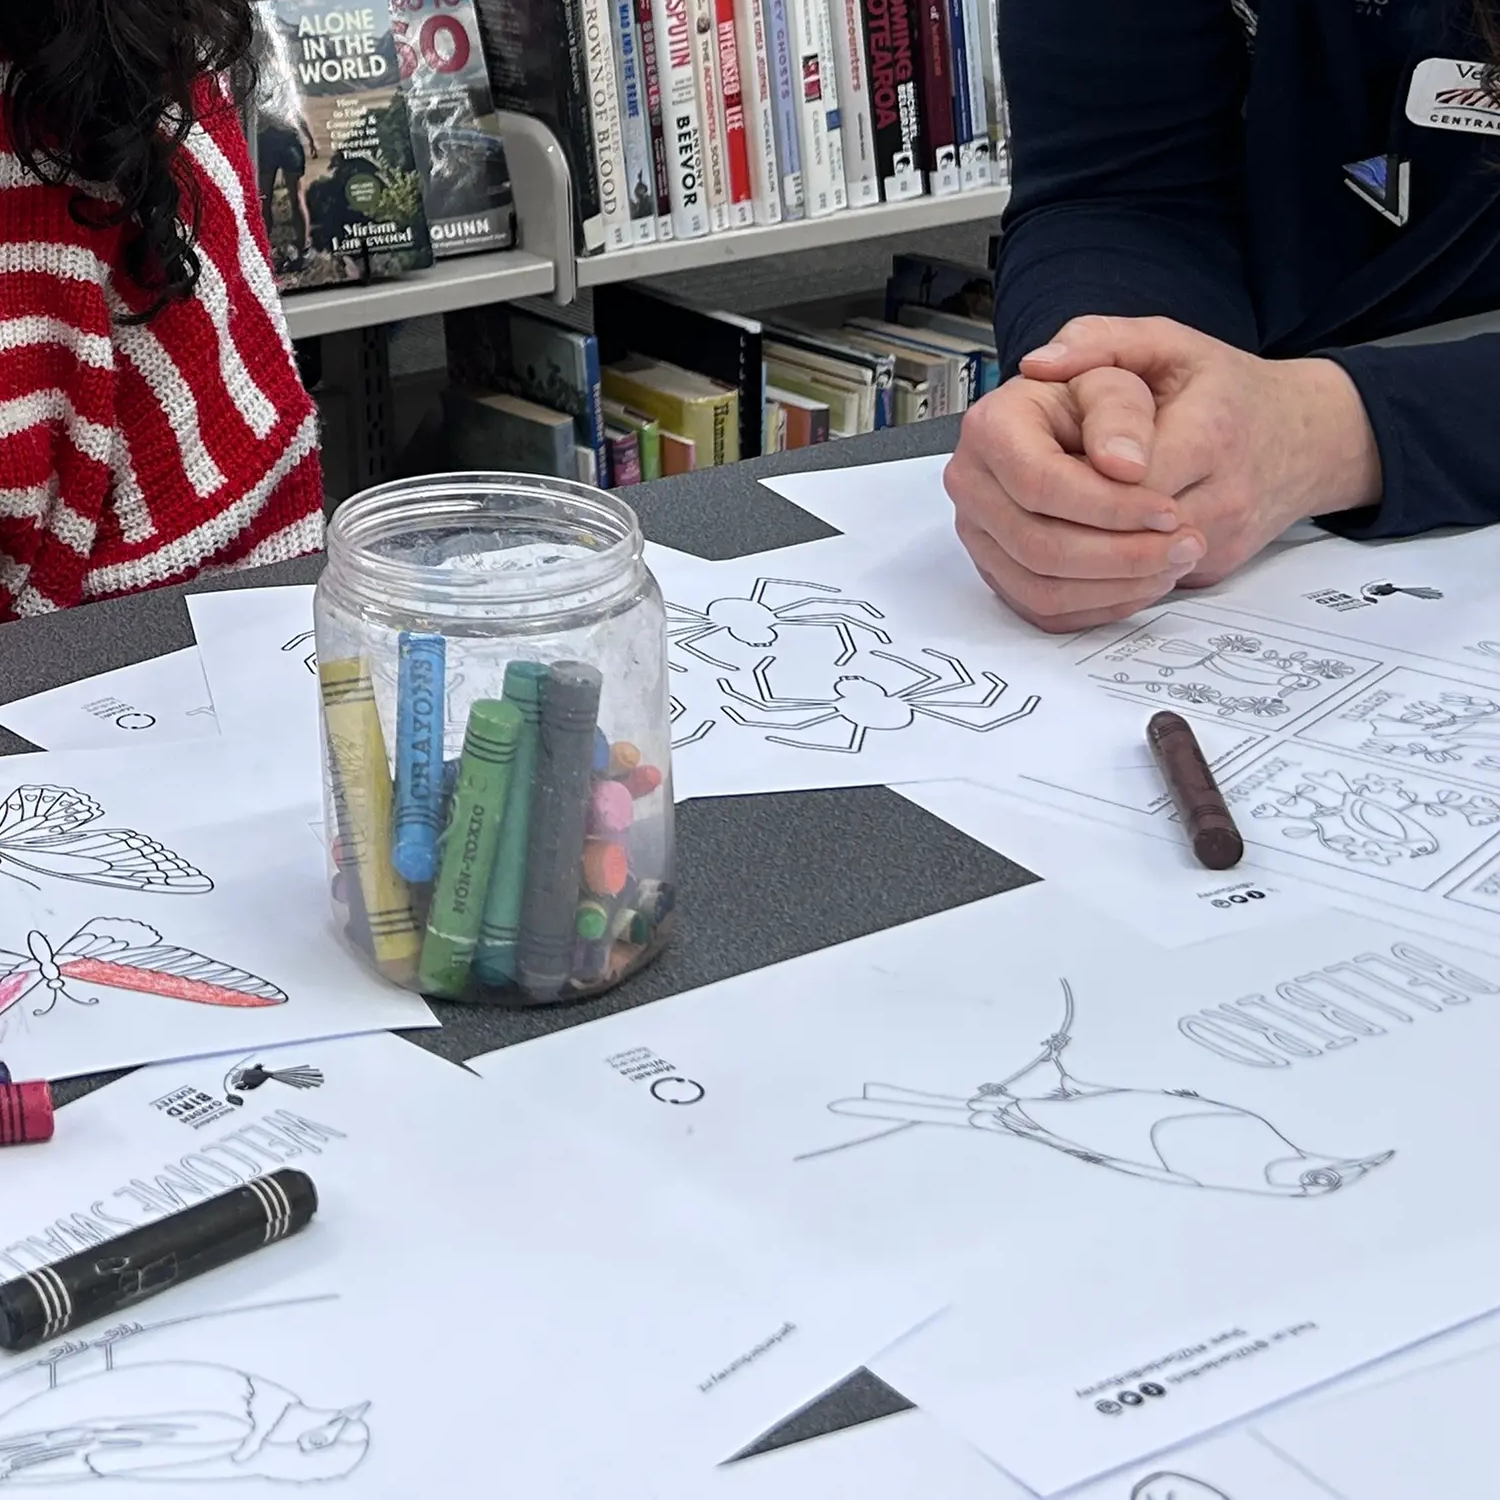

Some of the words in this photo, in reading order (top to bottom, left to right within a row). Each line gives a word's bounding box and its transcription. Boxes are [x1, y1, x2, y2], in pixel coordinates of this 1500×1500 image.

[298, 9, 375, 38] ALONE
[303, 35, 330, 61] IN
[329, 32, 376, 59] THE
[299, 54, 388, 85] WORLD
[336, 98, 360, 109] How
[330, 137, 379, 150] Uncertain
[675, 115, 697, 209] BEEVOR
[343, 222, 397, 236] Miriam
[429, 218, 490, 239] QUINN
[1315, 592, 1352, 605] BIRD
[409, 657, 435, 801] CRAYONS
[452, 803, 486, 916] NON-TOXIC
[1178, 942, 1500, 1069] BELLBIRD
[155, 1087, 198, 1111] SURVEY
[166, 1092, 213, 1117] BIRD
[220, 1106, 235, 1116] New
[179, 1100, 223, 1124] GARDEN
[192, 1112, 222, 1130] Zealand
